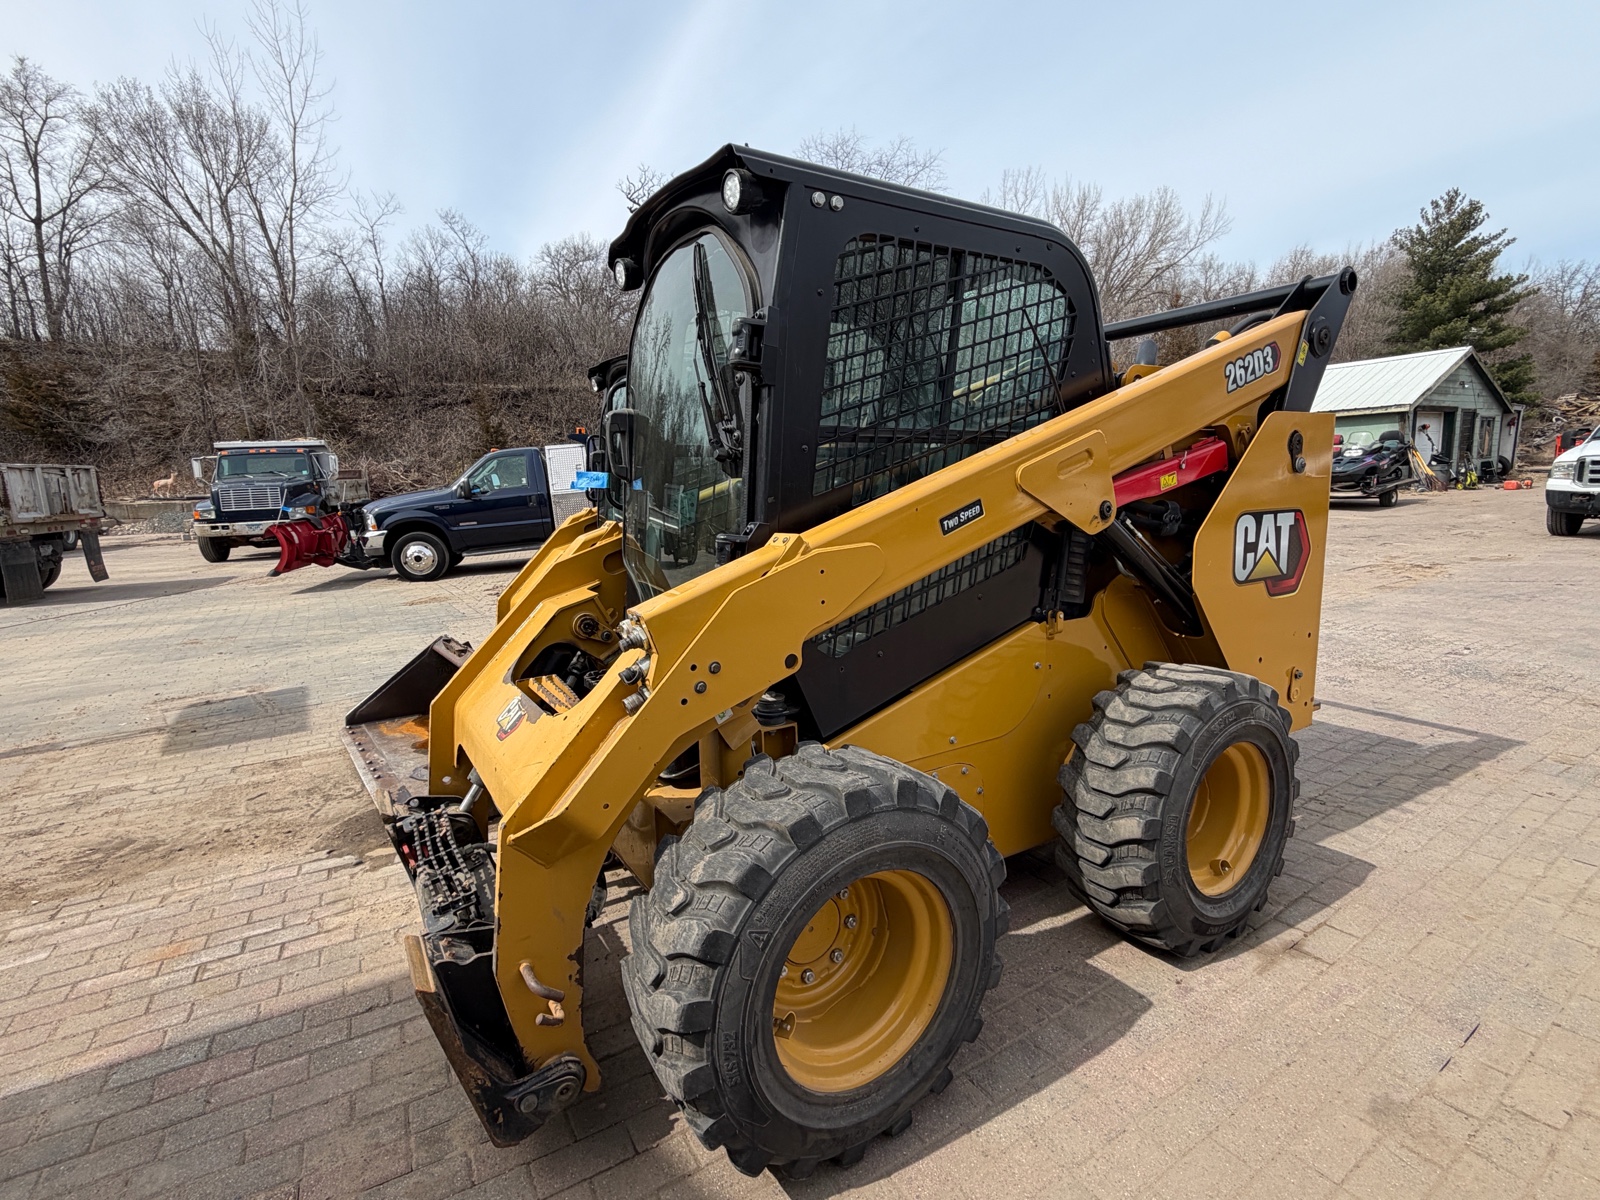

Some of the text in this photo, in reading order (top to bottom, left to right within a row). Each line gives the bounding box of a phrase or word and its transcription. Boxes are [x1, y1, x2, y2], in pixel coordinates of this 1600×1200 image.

[1225, 345, 1274, 393] 262D3
[1234, 512, 1295, 581] CAT
[497, 696, 523, 731] CAT
